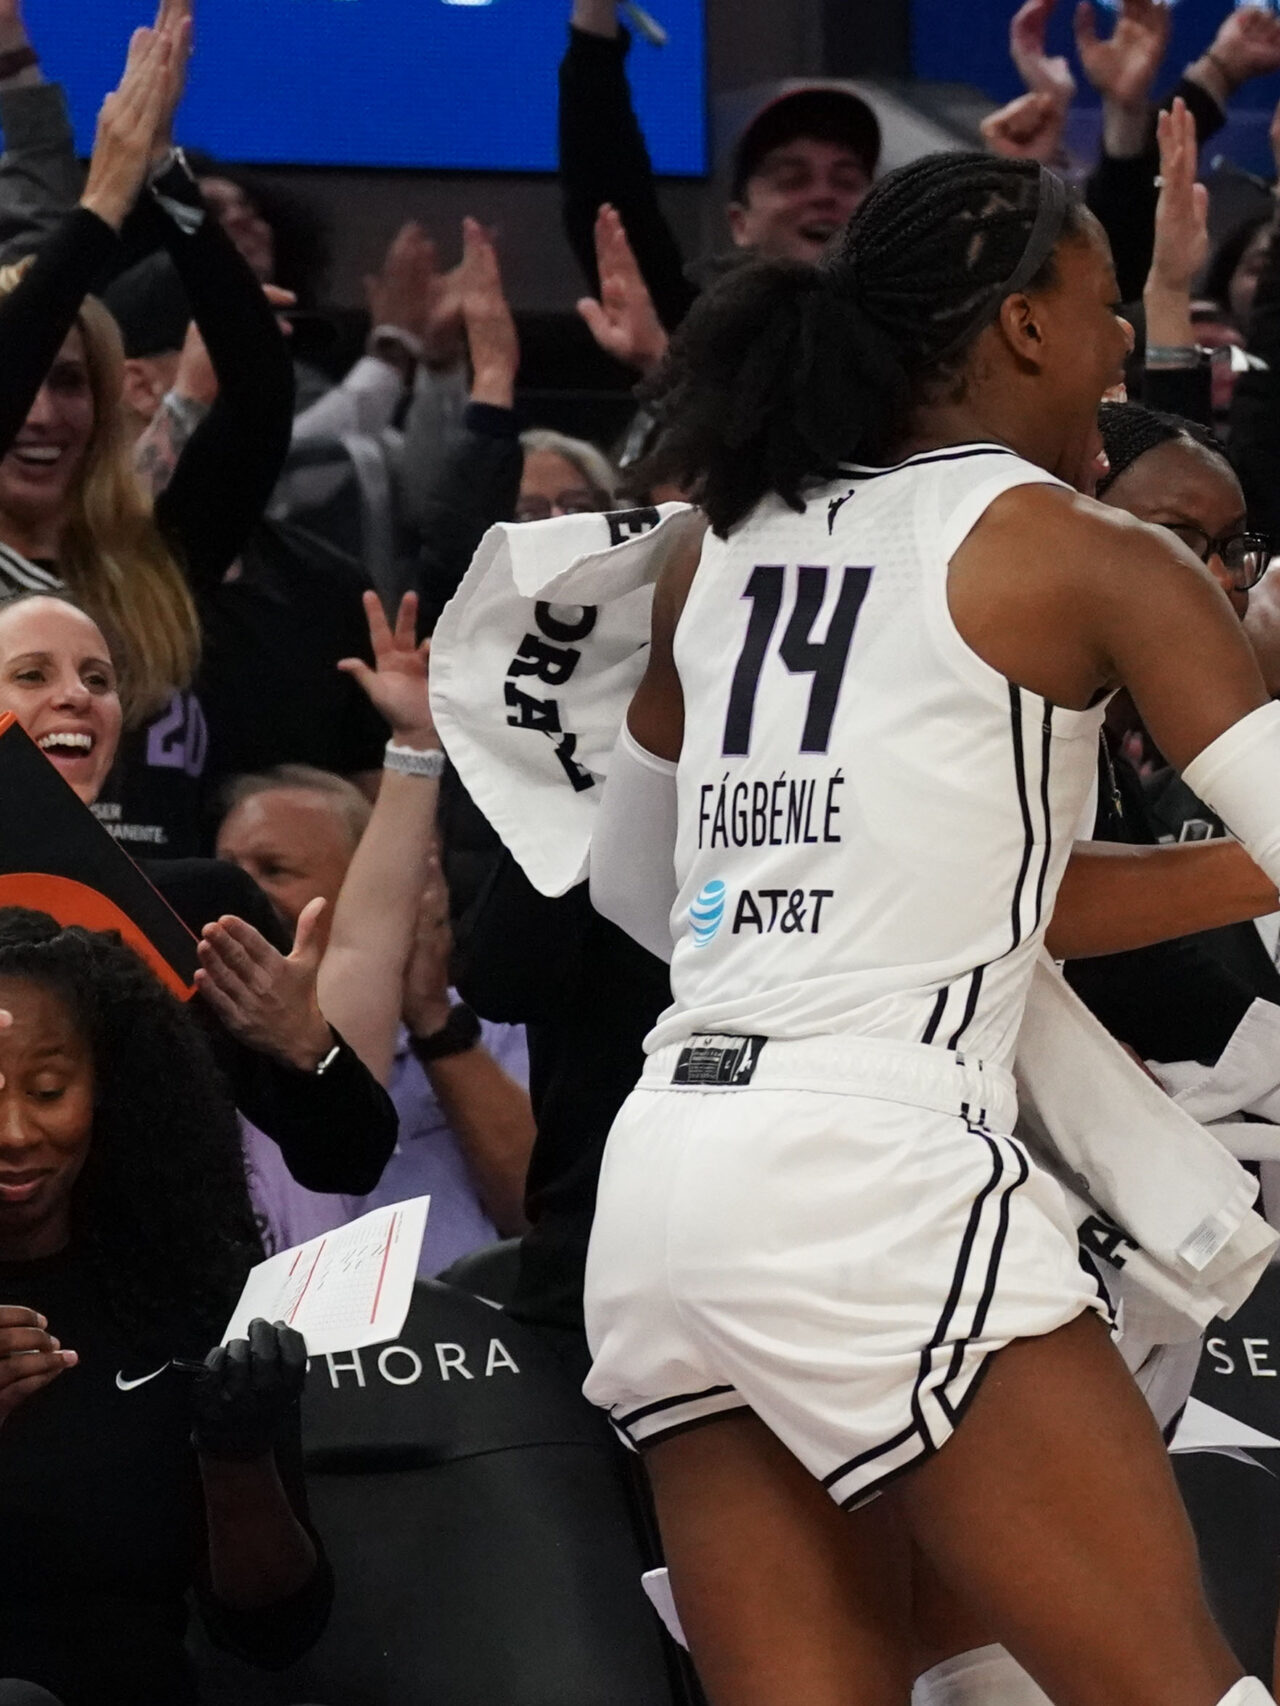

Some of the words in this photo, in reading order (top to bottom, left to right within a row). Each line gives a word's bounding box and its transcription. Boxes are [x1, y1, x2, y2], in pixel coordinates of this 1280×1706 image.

[721, 564, 875, 758] 14
[698, 768, 845, 850] FÁGBÉNLÉ
[732, 888, 834, 935] AT&T
[306, 1338, 520, 1389] HORA
